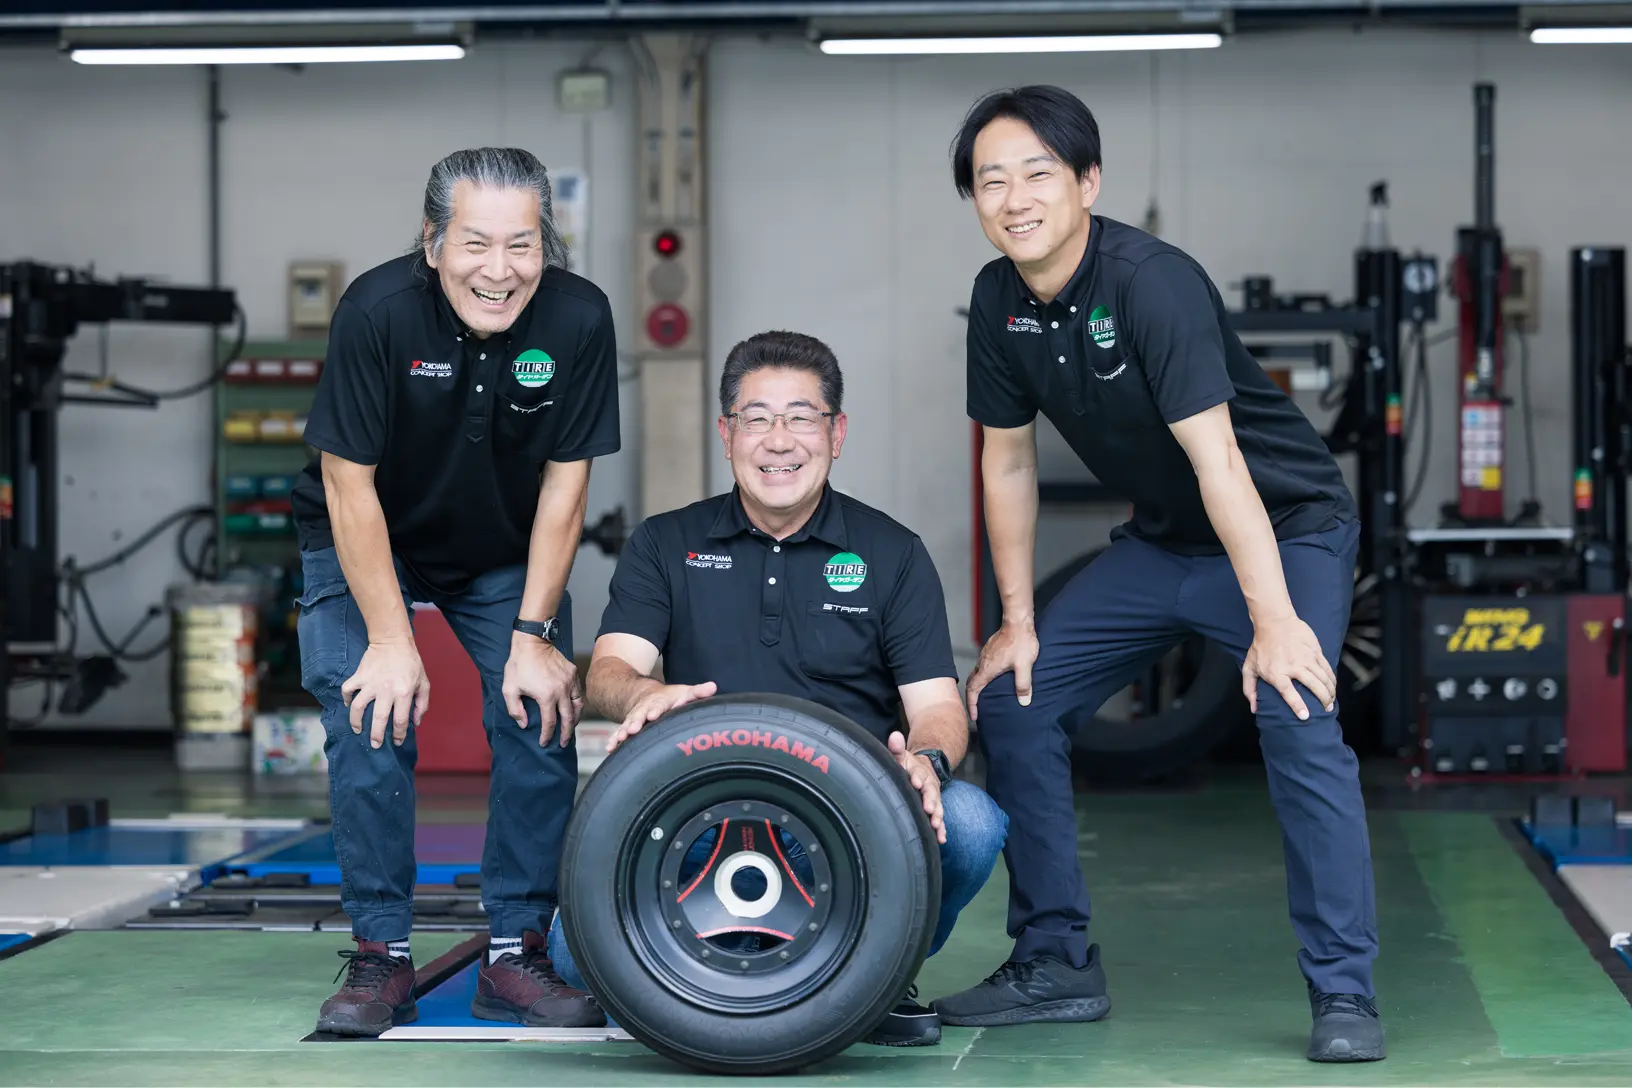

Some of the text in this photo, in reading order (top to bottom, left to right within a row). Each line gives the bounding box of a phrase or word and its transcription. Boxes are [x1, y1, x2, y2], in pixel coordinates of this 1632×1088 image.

[421, 361, 452, 370] YOKOHAMA
[514, 362, 553, 372] TIRE
[697, 553, 732, 562] YOKOHAMA
[826, 565, 864, 575] TIRE
[823, 603, 868, 614] STAFF
[676, 728, 830, 775] YOKOHAMA
